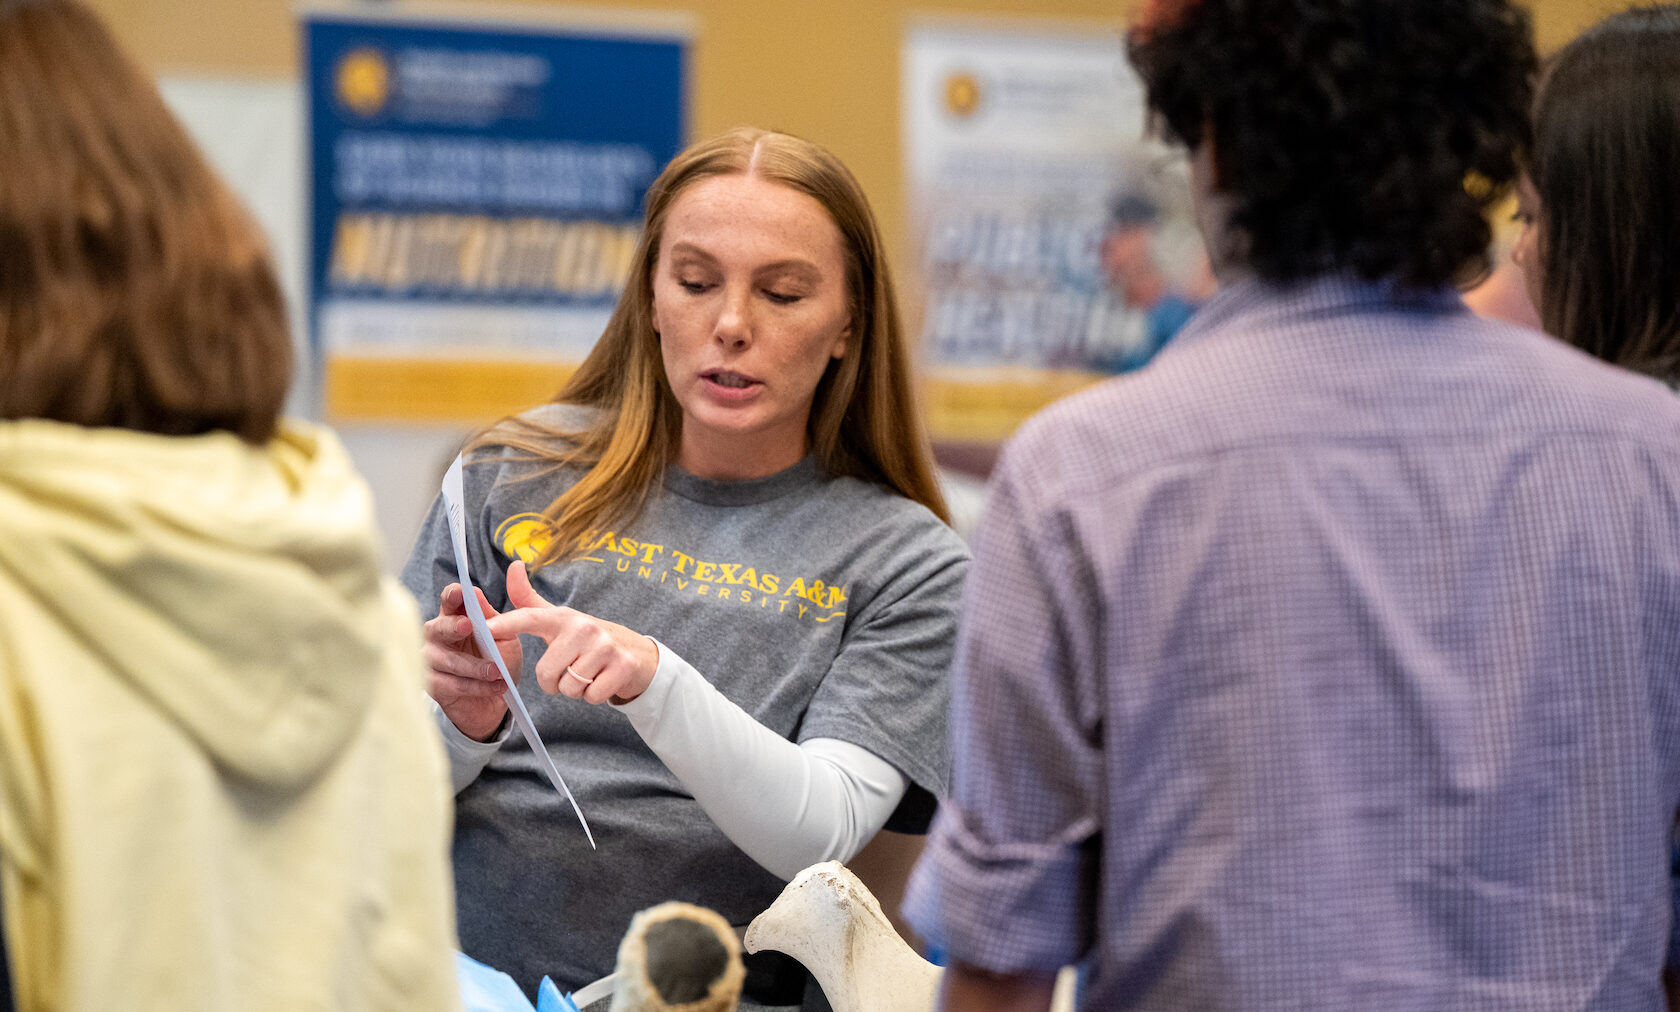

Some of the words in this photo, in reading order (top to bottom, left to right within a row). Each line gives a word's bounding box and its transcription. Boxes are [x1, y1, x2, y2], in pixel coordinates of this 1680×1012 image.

[617, 558, 808, 619] UNIVERSITY
[672, 550, 780, 594] TEXAS
[784, 577, 847, 608] A&M
